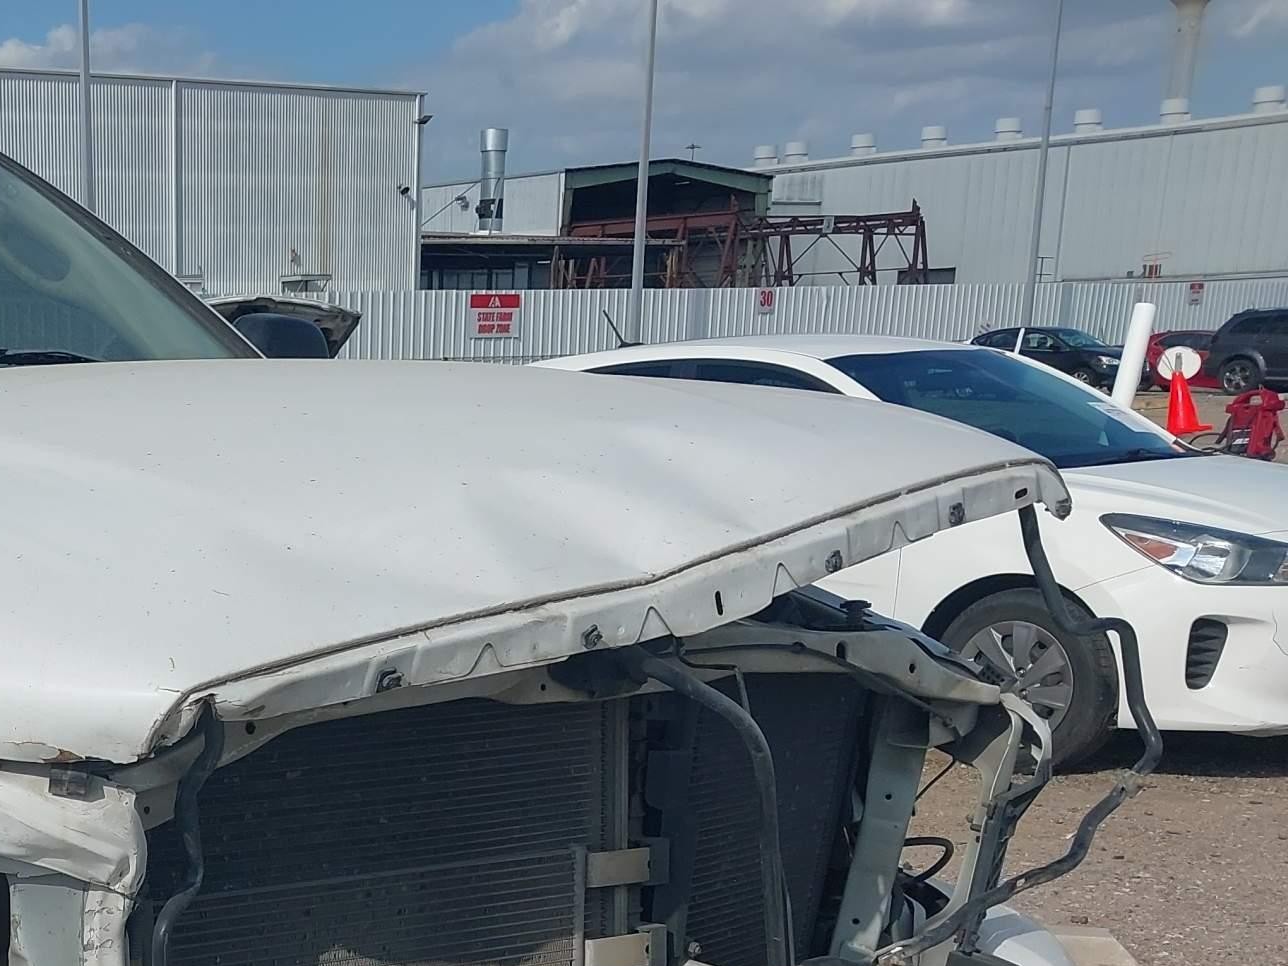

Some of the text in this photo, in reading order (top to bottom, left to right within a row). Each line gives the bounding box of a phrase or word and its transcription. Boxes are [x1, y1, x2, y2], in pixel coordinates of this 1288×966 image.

[760, 290, 773, 307] 30
[477, 312, 513, 322] STATE FARM
